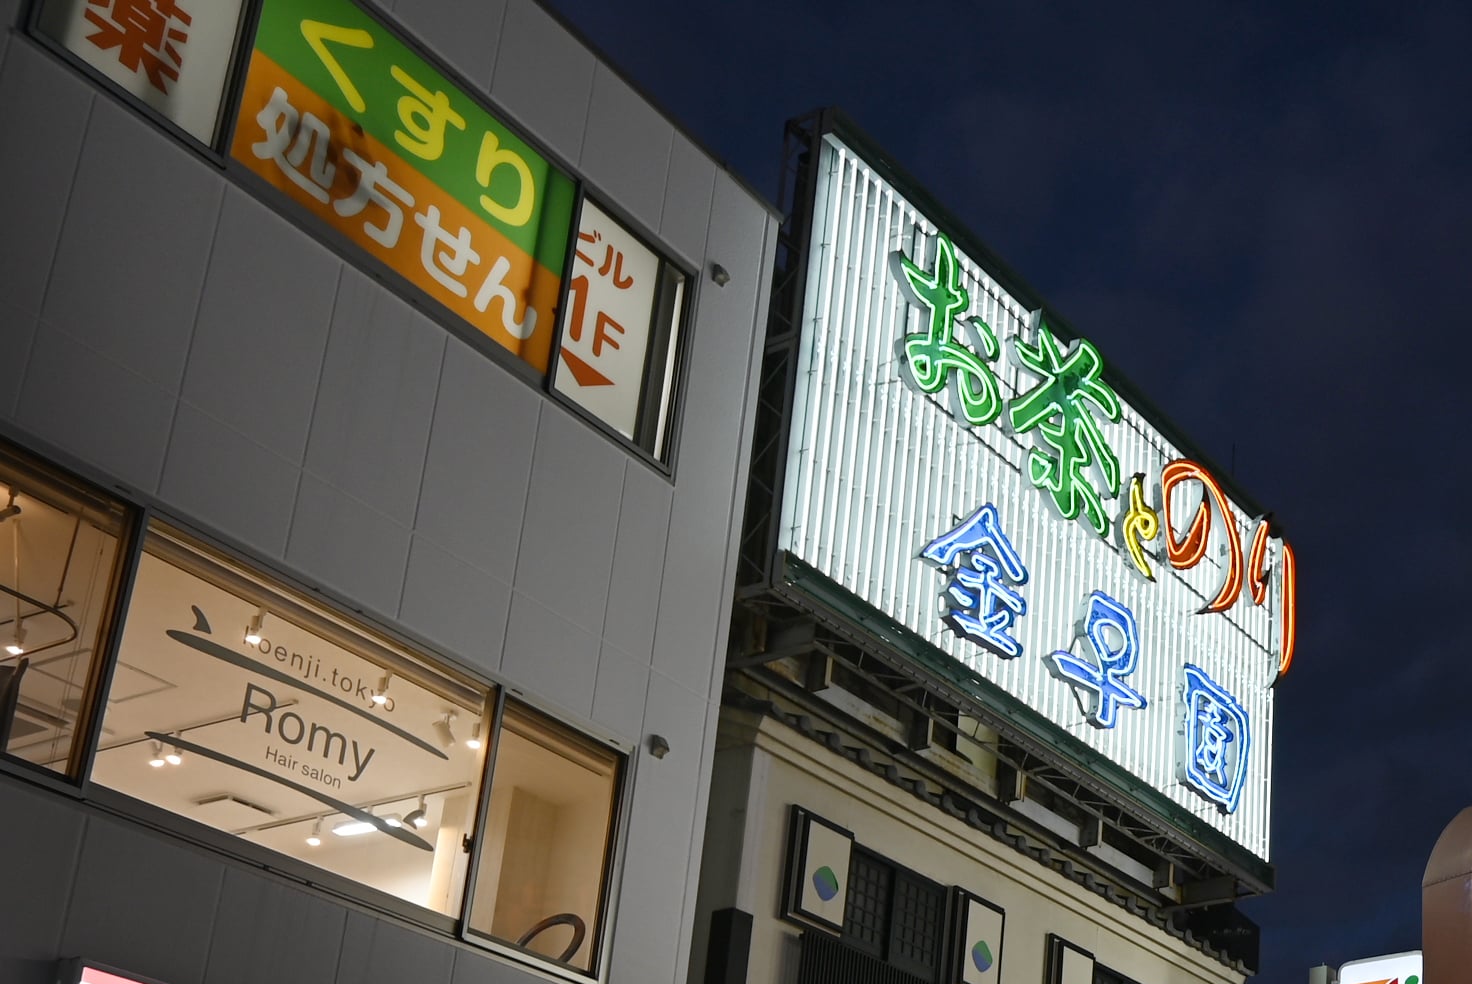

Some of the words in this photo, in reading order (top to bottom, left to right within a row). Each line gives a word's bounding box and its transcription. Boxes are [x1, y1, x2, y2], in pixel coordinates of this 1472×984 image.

[300, 18, 536, 227] くすり
[251, 86, 537, 341] 処方せん
[569, 274, 625, 358] 1F
[242, 625, 397, 713] koenji.tokyo
[239, 682, 376, 781] Romy
[264, 746, 299, 771] Hair
[301, 762, 342, 790] salon
